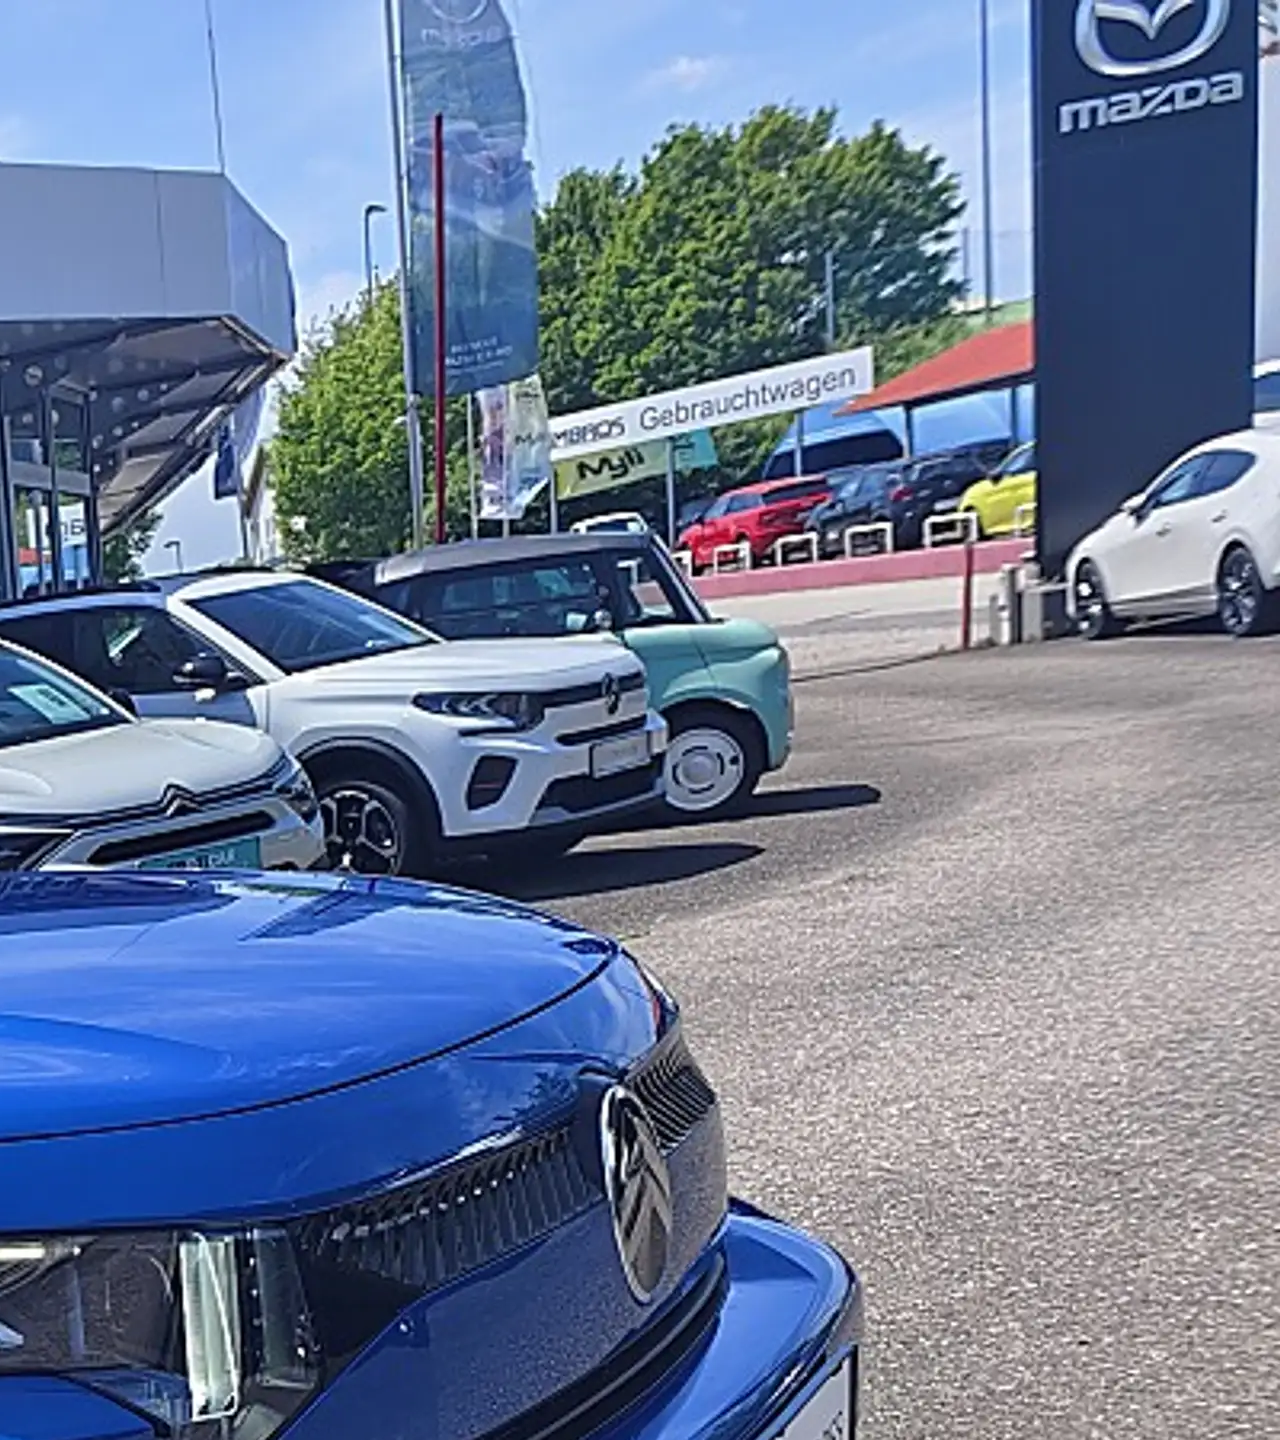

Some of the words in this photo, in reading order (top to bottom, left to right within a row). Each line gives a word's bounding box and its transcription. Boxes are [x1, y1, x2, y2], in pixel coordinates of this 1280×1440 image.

[1058, 71, 1244, 134] mazda
[550, 416, 626, 448] MBROS
[640, 367, 856, 431] Gebrauchtwagen
